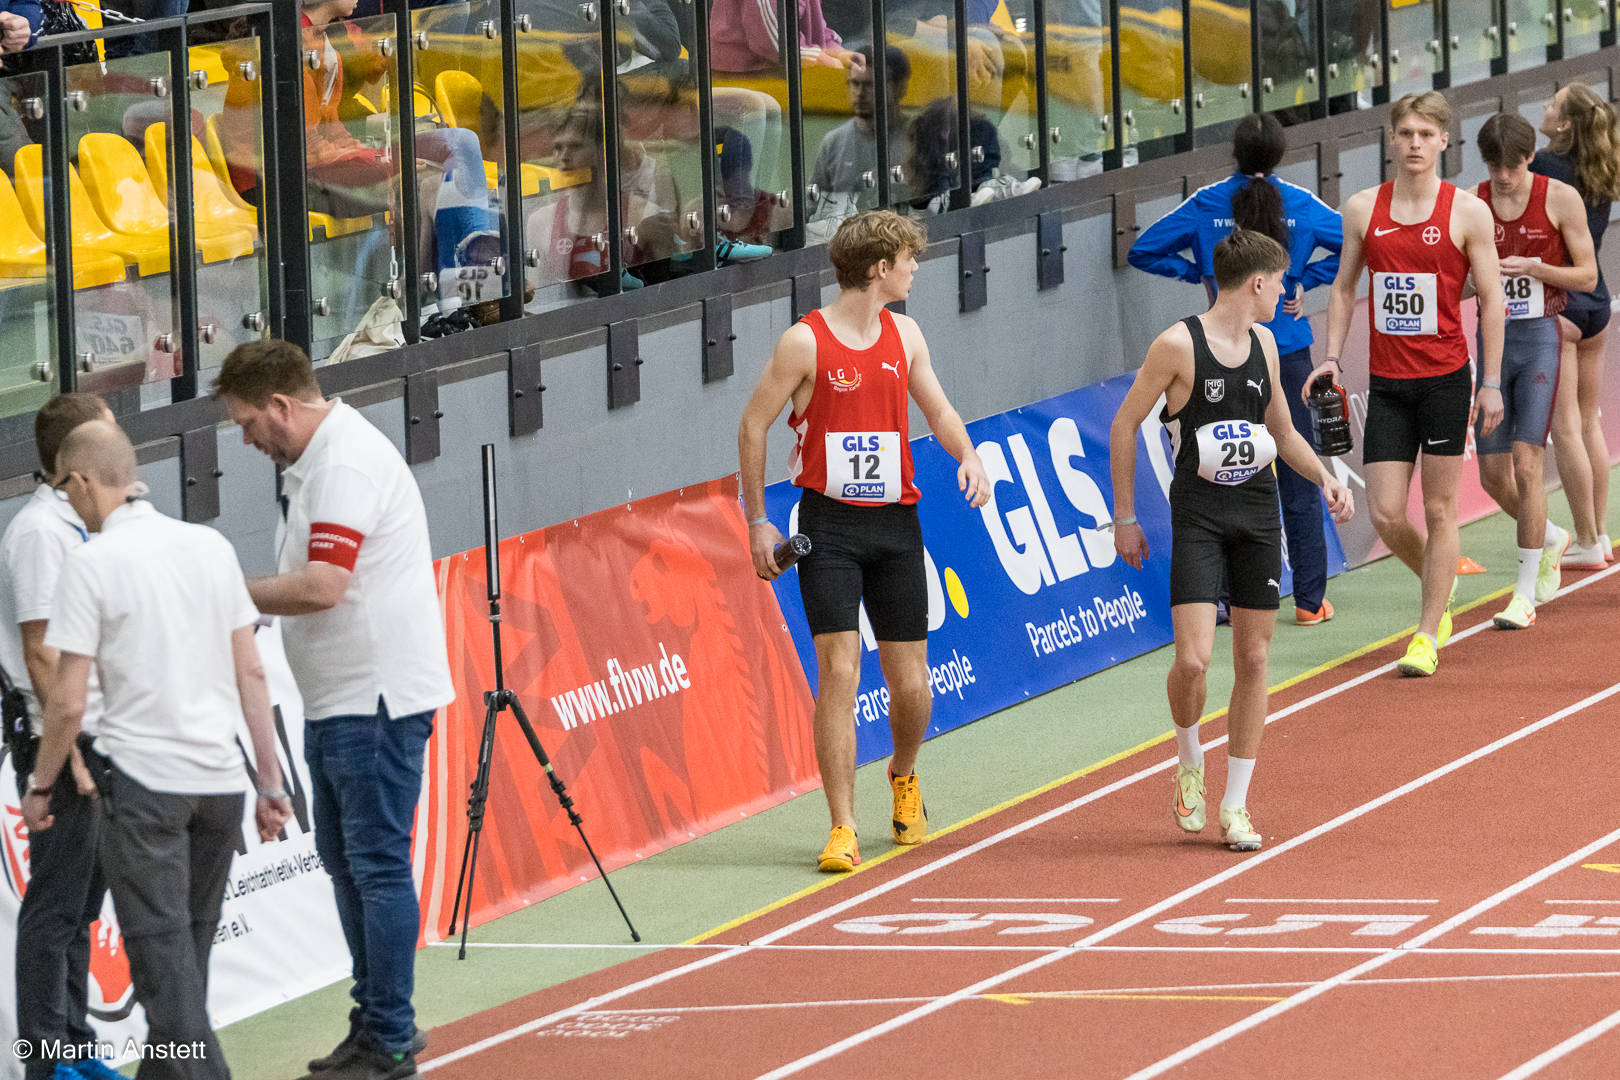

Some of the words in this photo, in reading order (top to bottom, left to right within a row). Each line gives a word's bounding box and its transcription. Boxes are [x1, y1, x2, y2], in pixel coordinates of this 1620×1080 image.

[1213, 218, 1223, 227] TV
[1382, 292, 1425, 316] 450
[1399, 319, 1420, 327] PLAN
[1207, 380, 1223, 388] MTG
[1221, 440, 1256, 467] 29
[849, 454, 881, 480] 12
[1232, 468, 1257, 478] PLAN
[860, 485, 884, 493] PLAN
[1025, 608, 1083, 658] Parcels
[1078, 605, 1100, 638] to
[1093, 584, 1147, 634] People
[550, 642, 691, 731] www.flvw.de
[853, 686, 890, 727] Parce
[230, 849, 325, 899] Leichtathletik-Verba
[833, 912, 1095, 935] 6
[1153, 913, 1431, 935] 5
